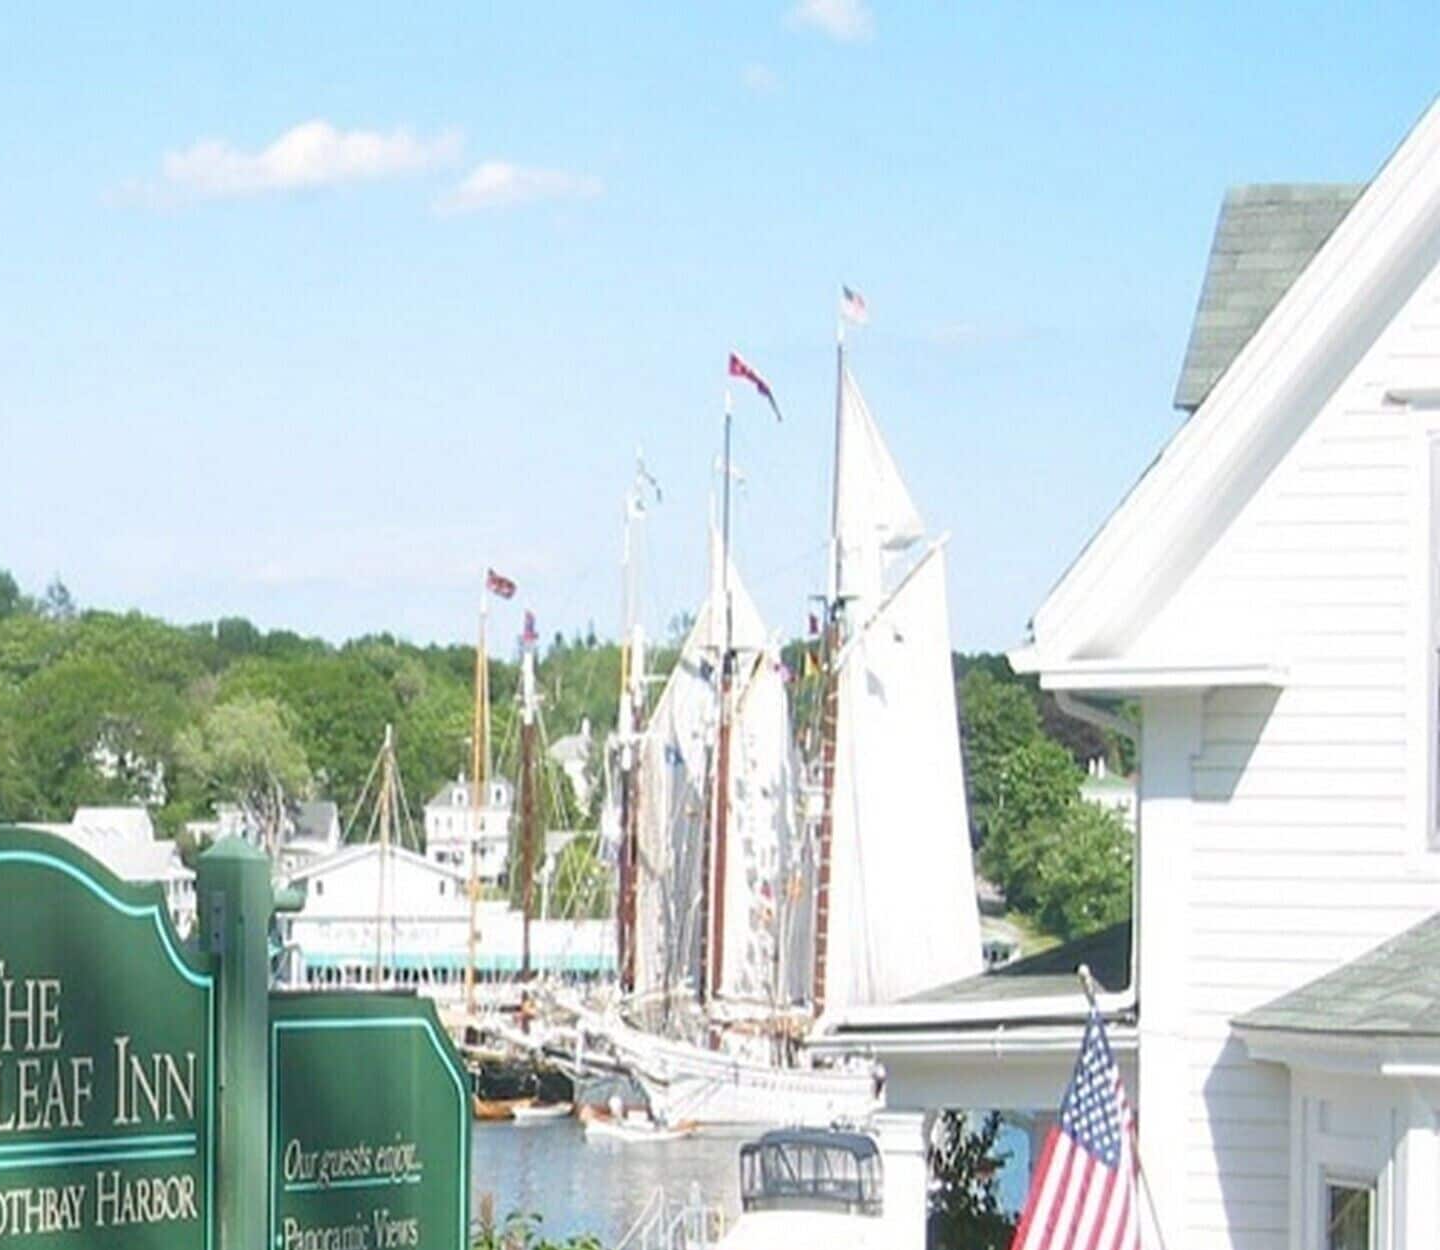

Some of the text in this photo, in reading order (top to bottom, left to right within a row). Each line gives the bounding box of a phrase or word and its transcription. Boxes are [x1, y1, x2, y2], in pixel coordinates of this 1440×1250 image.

[113, 1036, 197, 1126] INN
[284, 1138, 318, 1181] Our
[319, 1143, 373, 1188] guests
[95, 1170, 199, 1227] HARBOR
[373, 1209, 420, 1249] Views
